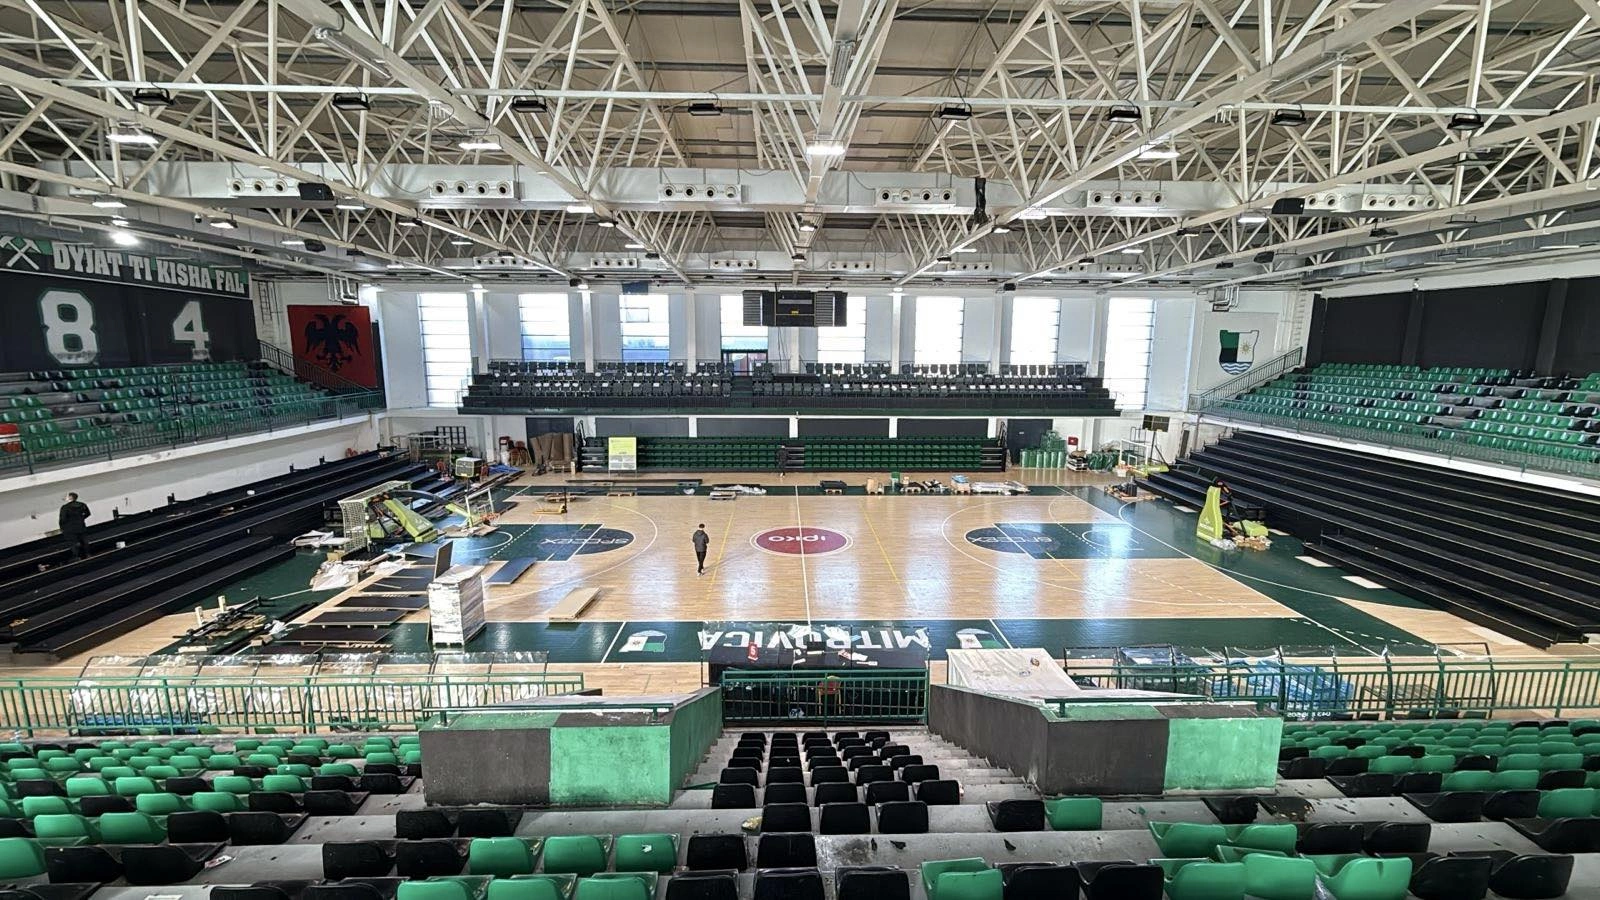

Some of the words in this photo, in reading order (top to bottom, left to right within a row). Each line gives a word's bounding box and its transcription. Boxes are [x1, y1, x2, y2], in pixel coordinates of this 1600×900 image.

[52, 241, 123, 277] DYJAT
[128, 255, 153, 281] TI
[156, 259, 213, 290] KISHA
[215, 269, 245, 294] FAL
[41, 290, 98, 364] 8
[173, 301, 210, 361] 4
